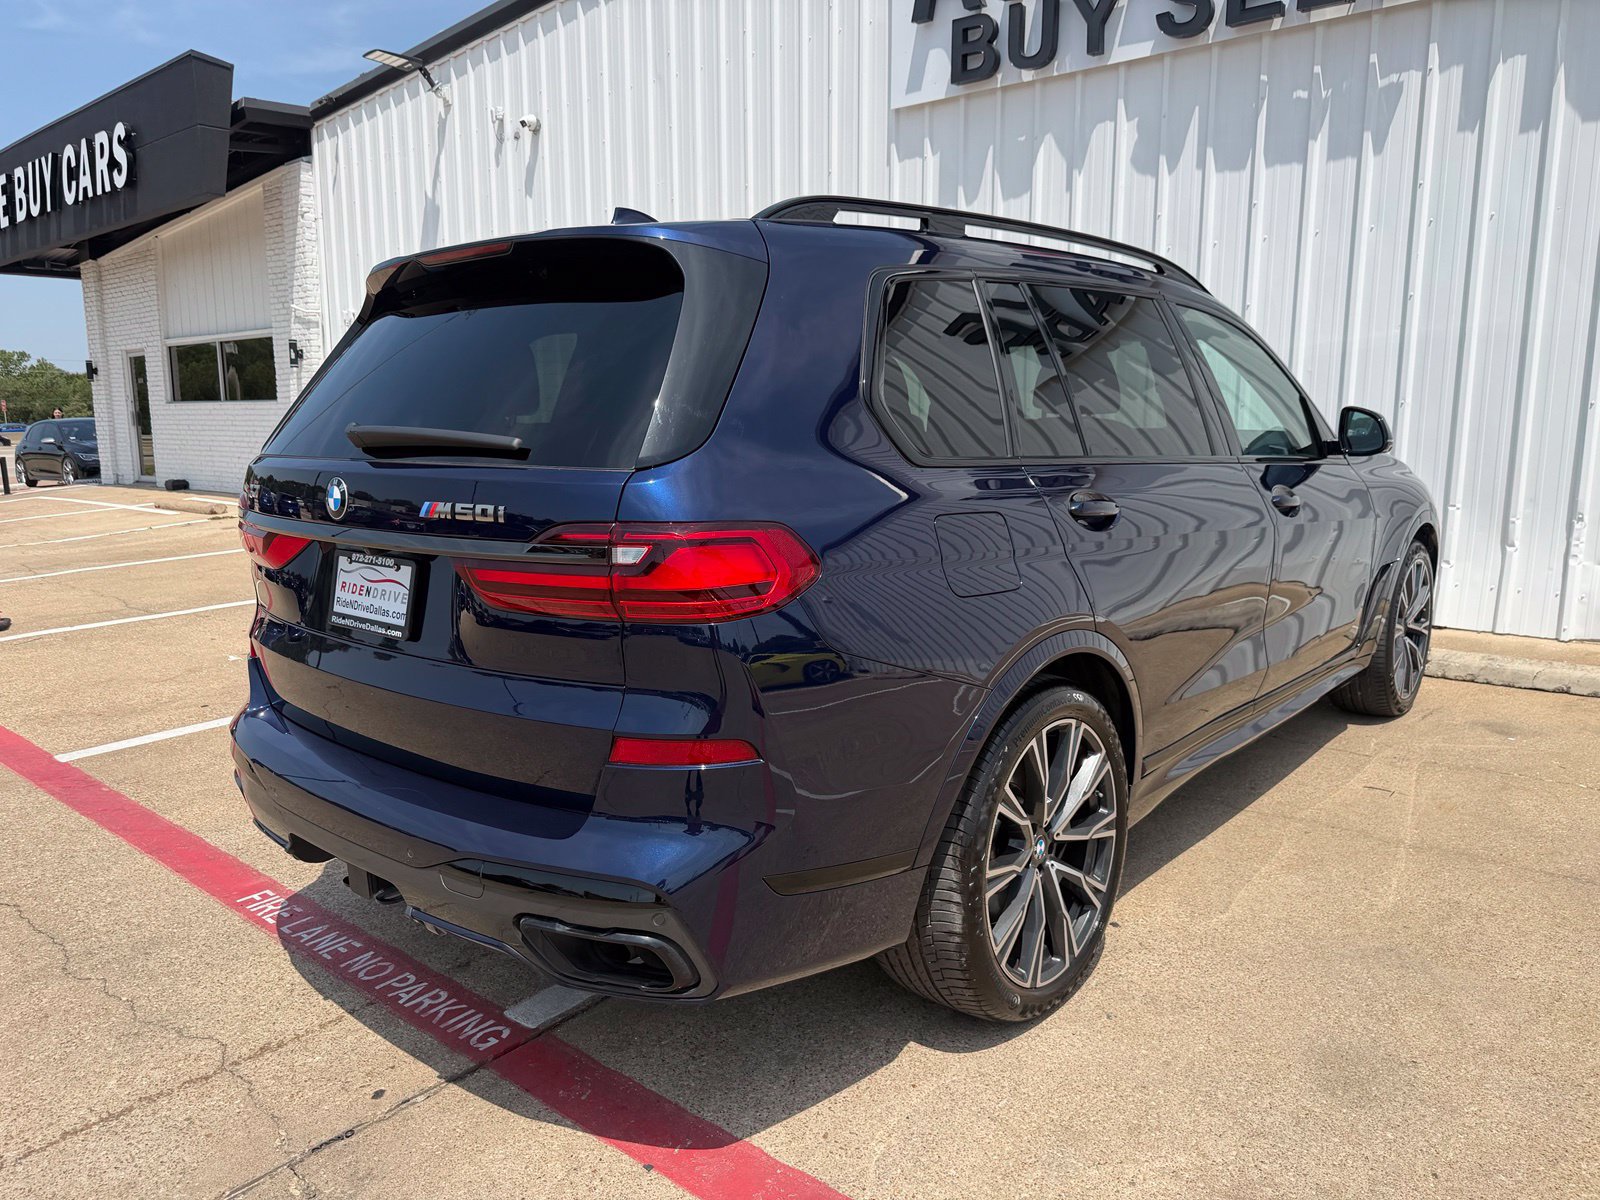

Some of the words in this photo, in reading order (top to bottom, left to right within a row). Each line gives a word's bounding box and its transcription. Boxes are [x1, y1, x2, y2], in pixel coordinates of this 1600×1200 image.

[951, 0, 1117, 86] BUY
[14, 152, 52, 223] BUY
[62, 121, 128, 205] CARS
[432, 501, 506, 523] M50i
[351, 553, 394, 566] 972-271-5100
[336, 597, 406, 620] RideNDriveDallas.com
[331, 615, 402, 637] RideNDriveDallas.com
[236, 889, 303, 925] FIRE
[280, 915, 362, 960] LANE
[340, 951, 394, 982] NO
[376, 972, 511, 1051] PARKING
